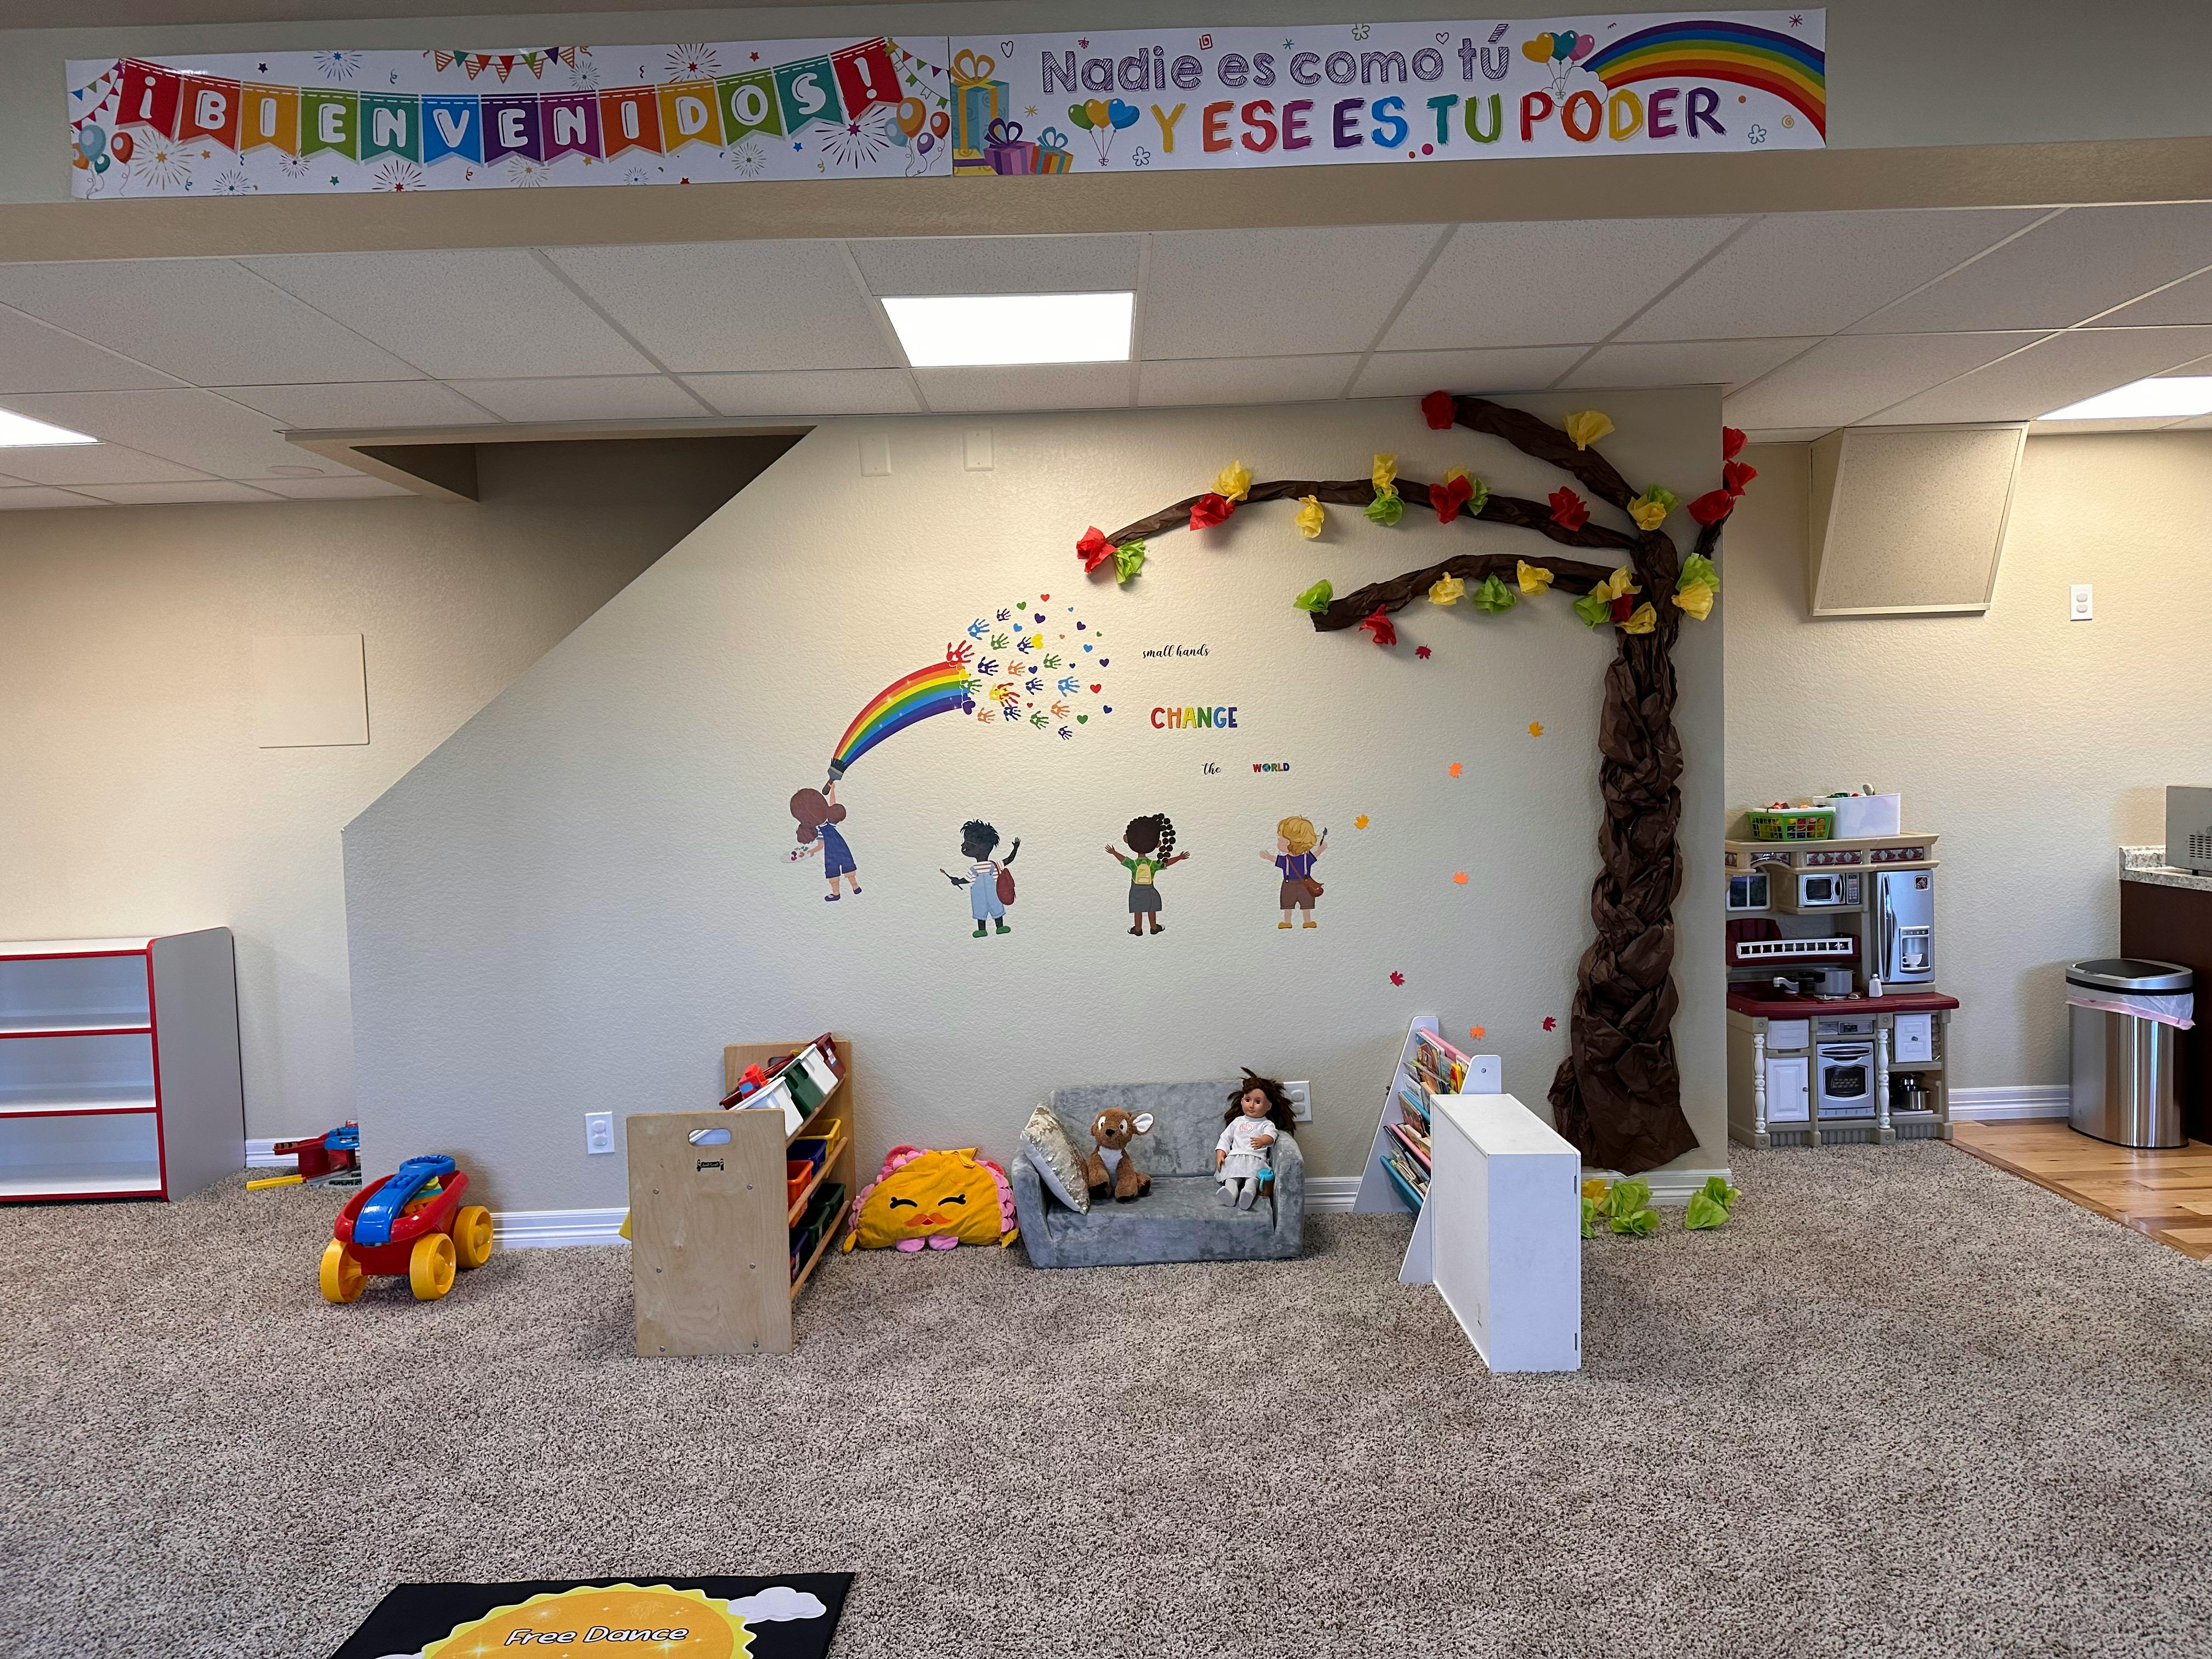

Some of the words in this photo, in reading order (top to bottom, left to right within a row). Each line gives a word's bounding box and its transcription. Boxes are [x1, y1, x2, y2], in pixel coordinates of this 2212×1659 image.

[1041, 46, 1203, 94] Nadie
[1217, 51, 1277, 87] es
[1289, 47, 1444, 86] como
[1457, 24, 1510, 82] tú
[1150, 102, 1187, 154] Y
[1203, 99, 1316, 154] ESE
[1332, 95, 1409, 150] ES
[1426, 93, 1502, 146] TU
[1520, 87, 1726, 143] PODER
[1142, 645, 1175, 659] small
[1176, 644, 1211, 657] hands
[1150, 706, 1238, 729] CHANGE
[1201, 762, 1222, 775] the
[1252, 762, 1290, 773] WORLD
[504, 1628, 577, 1646] Free
[583, 1626, 689, 1644] Dance
